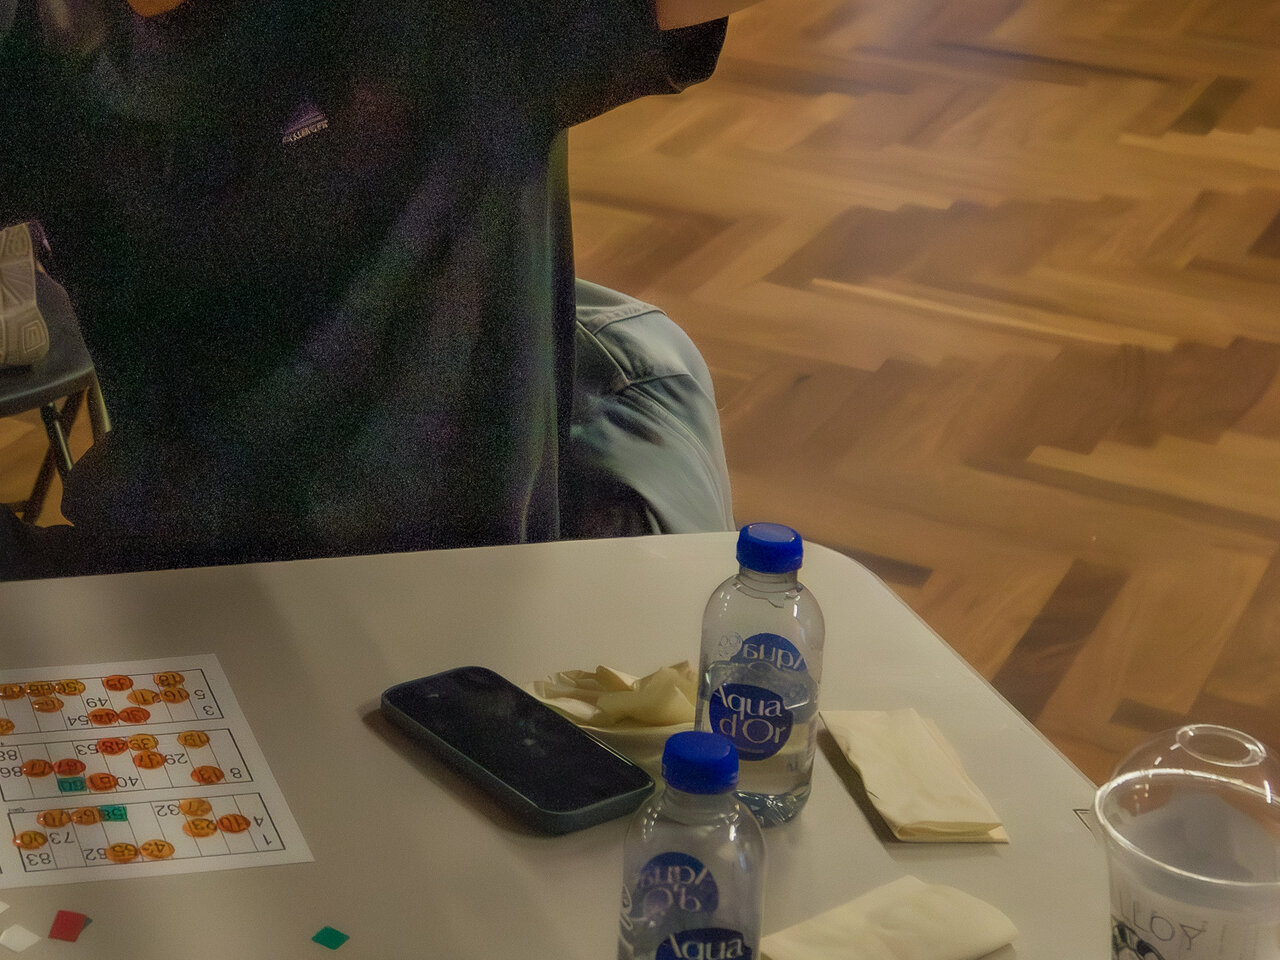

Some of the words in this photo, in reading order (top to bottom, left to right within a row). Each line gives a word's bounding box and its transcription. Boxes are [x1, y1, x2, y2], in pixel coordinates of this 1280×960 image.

[194, 690, 206, 700] 5
[86, 697, 108, 708] 49
[719, 685, 783, 721] Aqua
[202, 705, 215, 716] 3
[67, 715, 89, 726] 54
[164, 753, 188, 765] 29
[0, 766, 23, 778] 86
[230, 768, 242, 779] 8
[116, 776, 138, 788] 40
[154, 804, 180, 818] 32
[253, 816, 264, 828] 4
[49, 832, 75, 844] 73
[262, 834, 272, 846] 1
[26, 852, 52, 866] 83
[669, 933, 744, 960] Aqua
